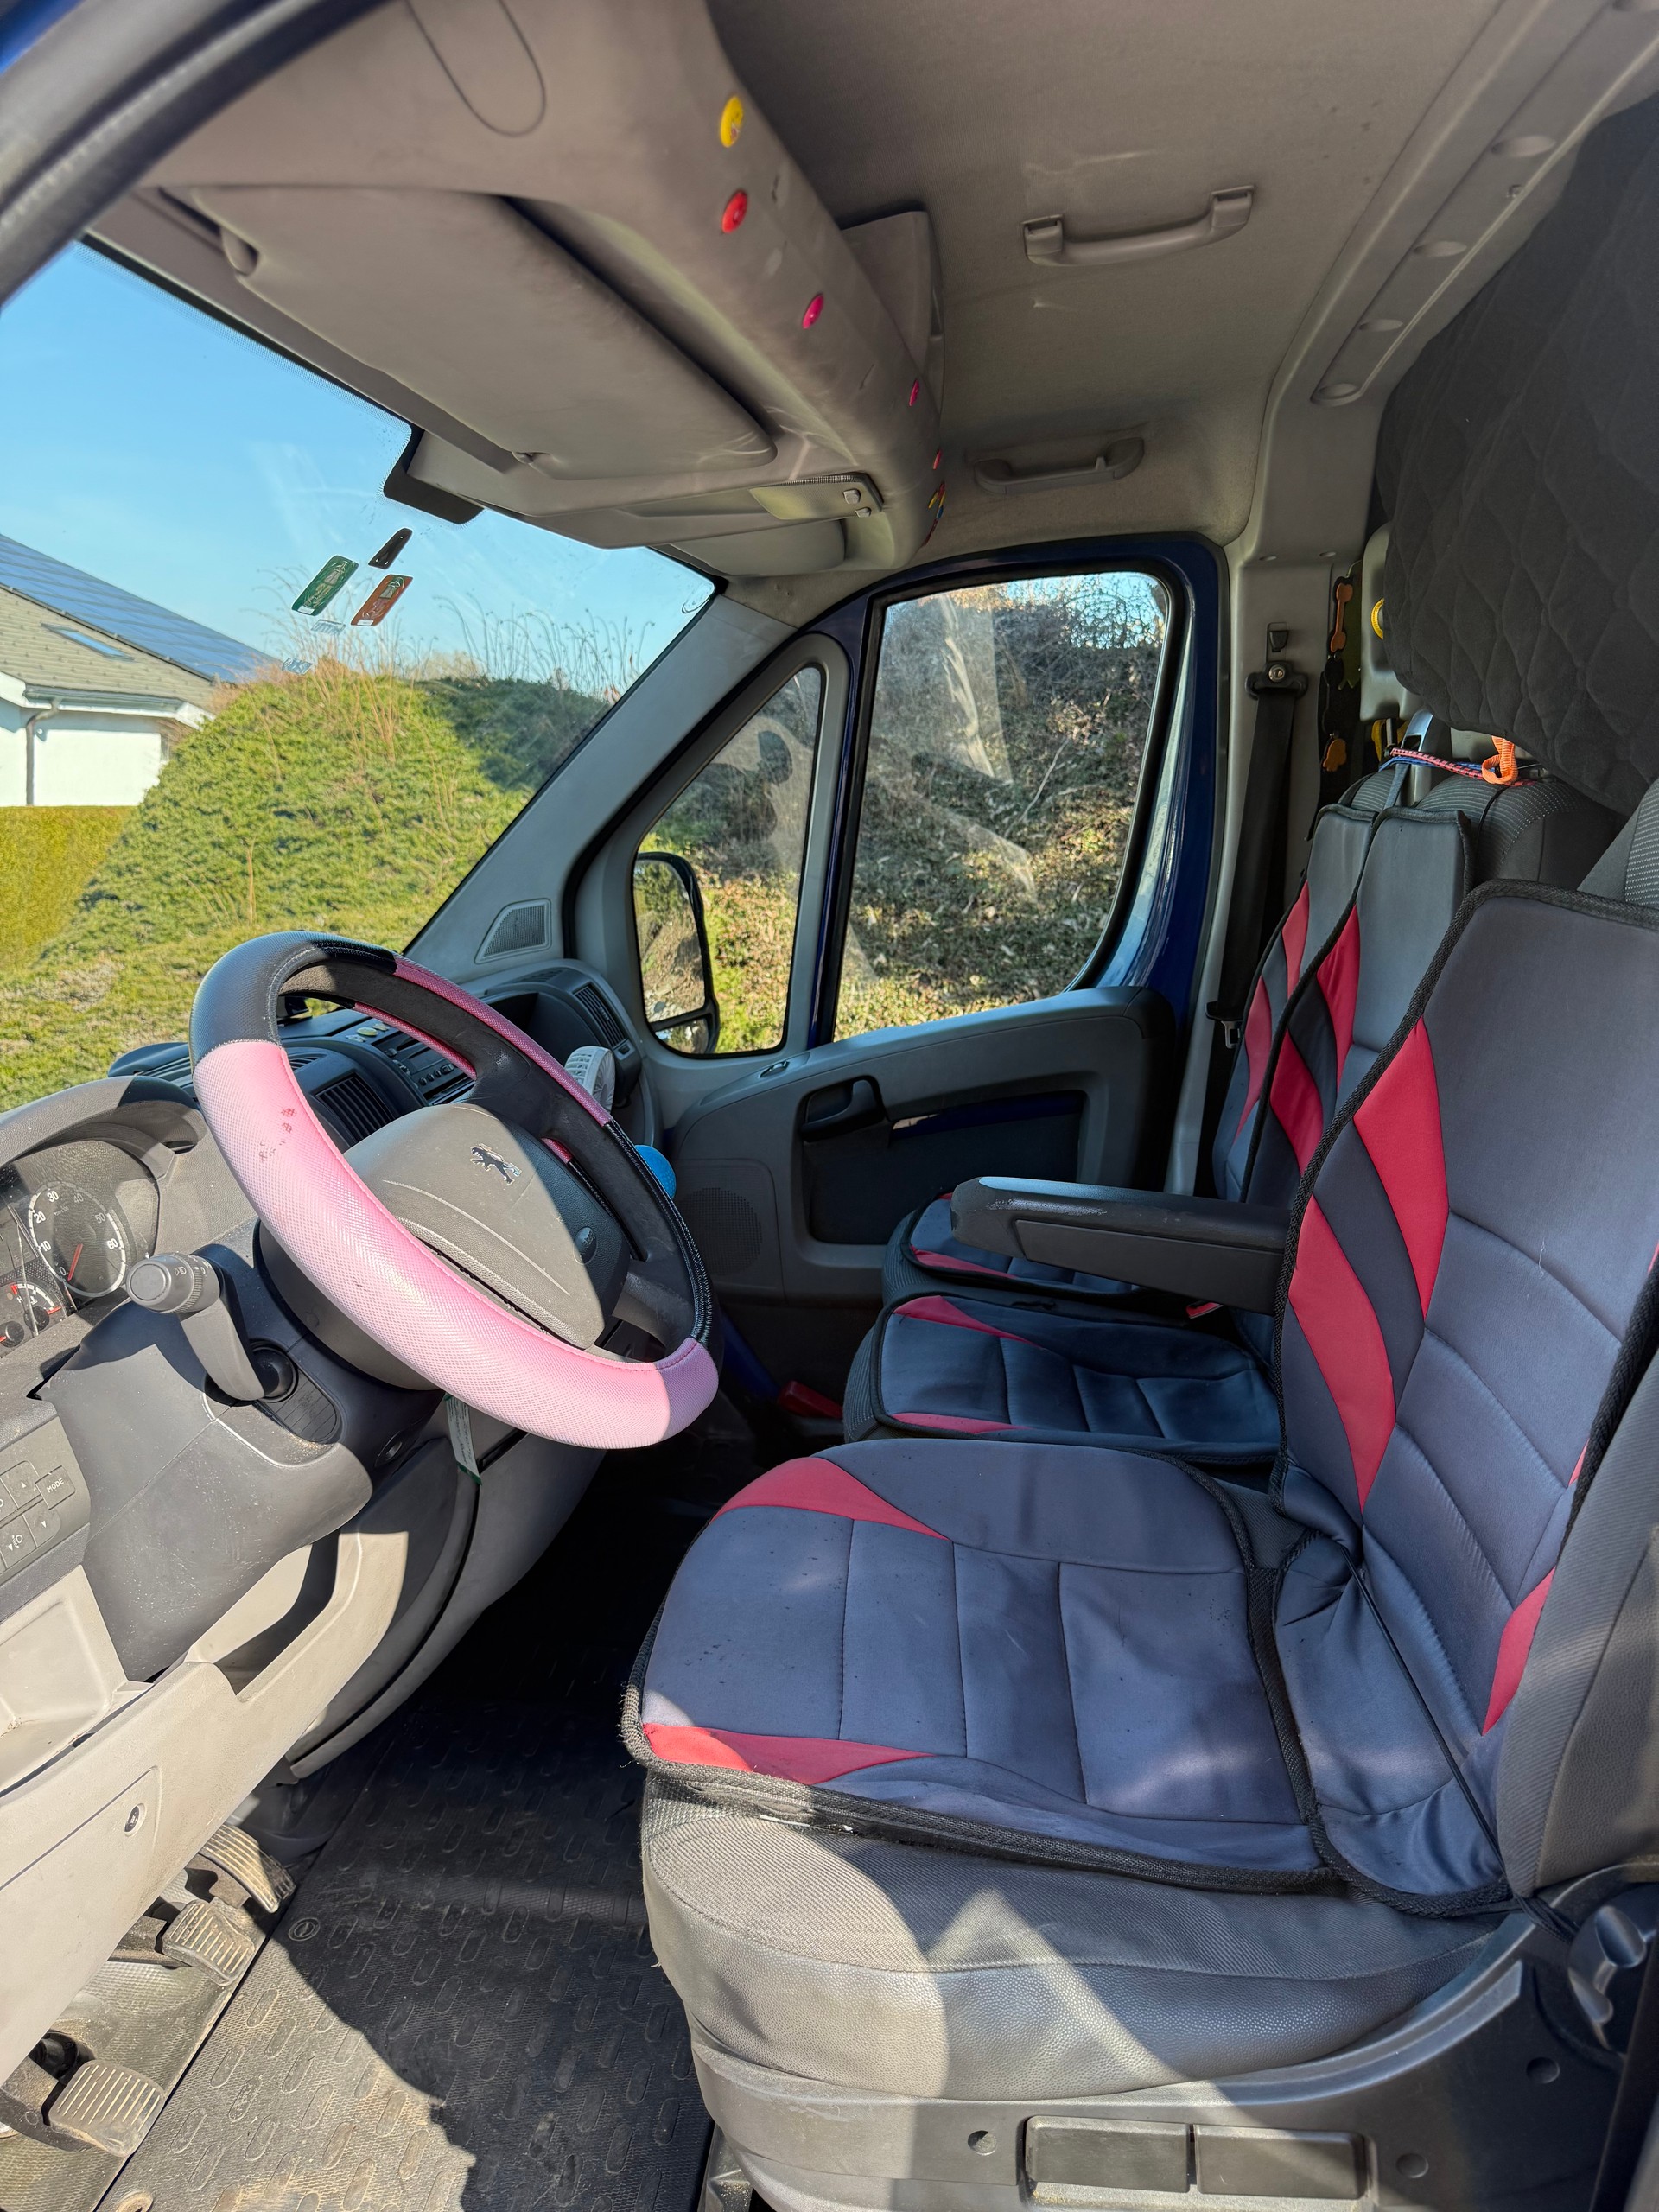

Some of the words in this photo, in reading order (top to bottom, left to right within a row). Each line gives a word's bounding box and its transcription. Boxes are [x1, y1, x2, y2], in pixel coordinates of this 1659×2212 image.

[47, 1190, 59, 1202] 30
[73, 1192, 84, 1204] 40
[34, 1211, 46, 1224] 20
[95, 1212, 105, 1224] 50
[40, 1240, 51, 1252] 10
[106, 1238, 118, 1250] 60
[60, 1267, 66, 1276] 0
[46, 1478, 65, 1493] MODE
